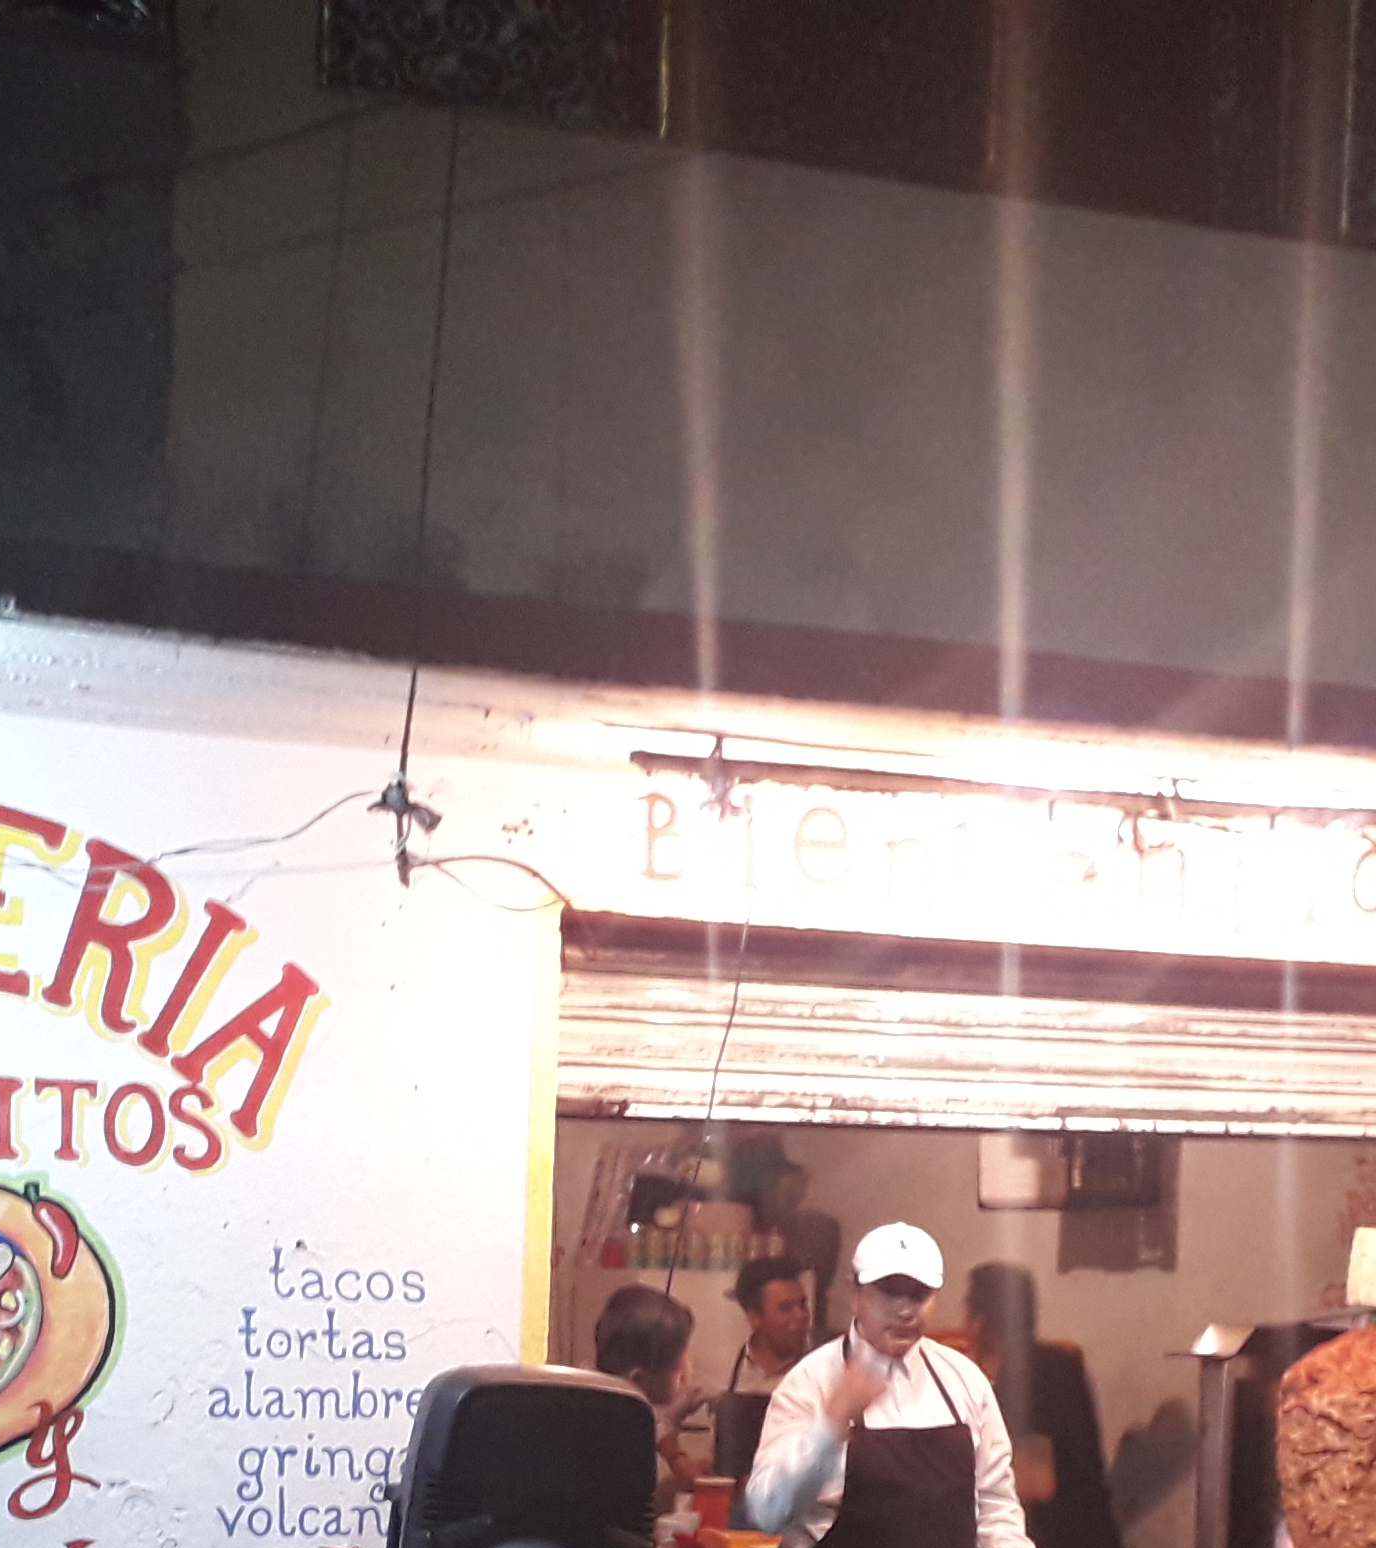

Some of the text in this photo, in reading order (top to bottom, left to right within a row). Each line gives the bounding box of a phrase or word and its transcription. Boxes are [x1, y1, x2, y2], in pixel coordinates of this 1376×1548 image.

[269, 1246, 426, 1302] tacos
[238, 1308, 408, 1361] tortas
[8, 1402, 101, 1520] y
[236, 1437, 408, 1503] gring
